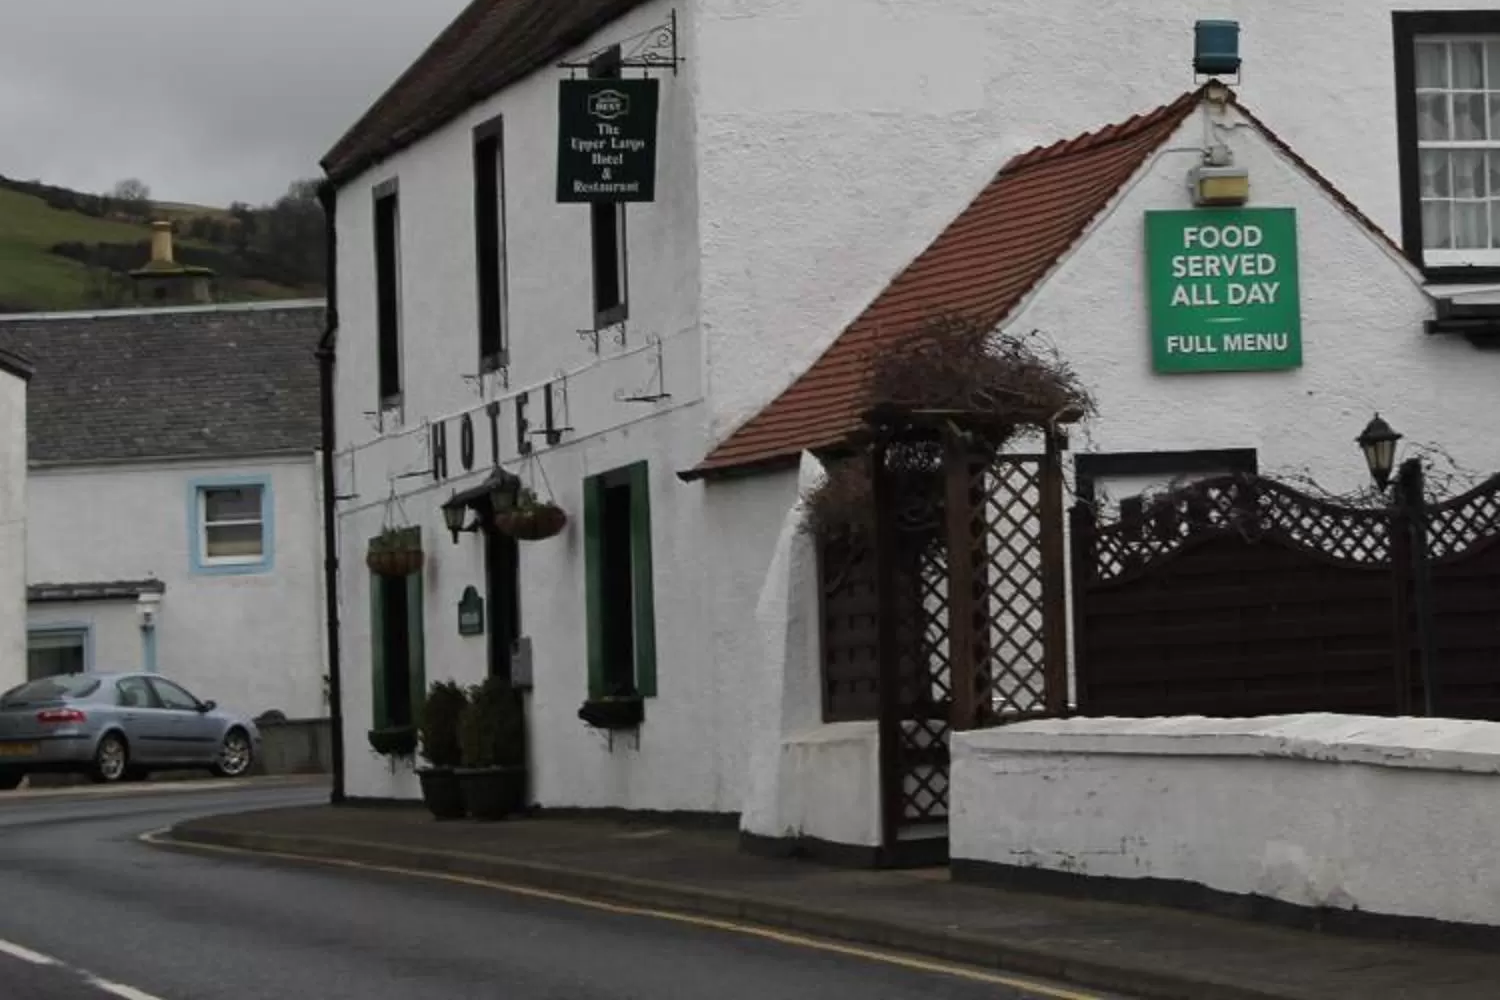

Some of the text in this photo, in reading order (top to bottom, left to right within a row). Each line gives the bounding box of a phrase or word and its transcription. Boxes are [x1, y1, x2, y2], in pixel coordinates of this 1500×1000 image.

[597, 123, 620, 135] The
[571, 137, 645, 152] Upper Largo
[592, 153, 623, 165] Hotel
[601, 167, 612, 180] &
[573, 180, 640, 193] Restaurant
[1183, 225, 1263, 249] FOOD
[1171, 253, 1277, 278] SERVED
[1170, 282, 1281, 307] ALL DAY
[1167, 332, 1289, 354] FULL MENU
[432, 382, 561, 481] HOTEL
